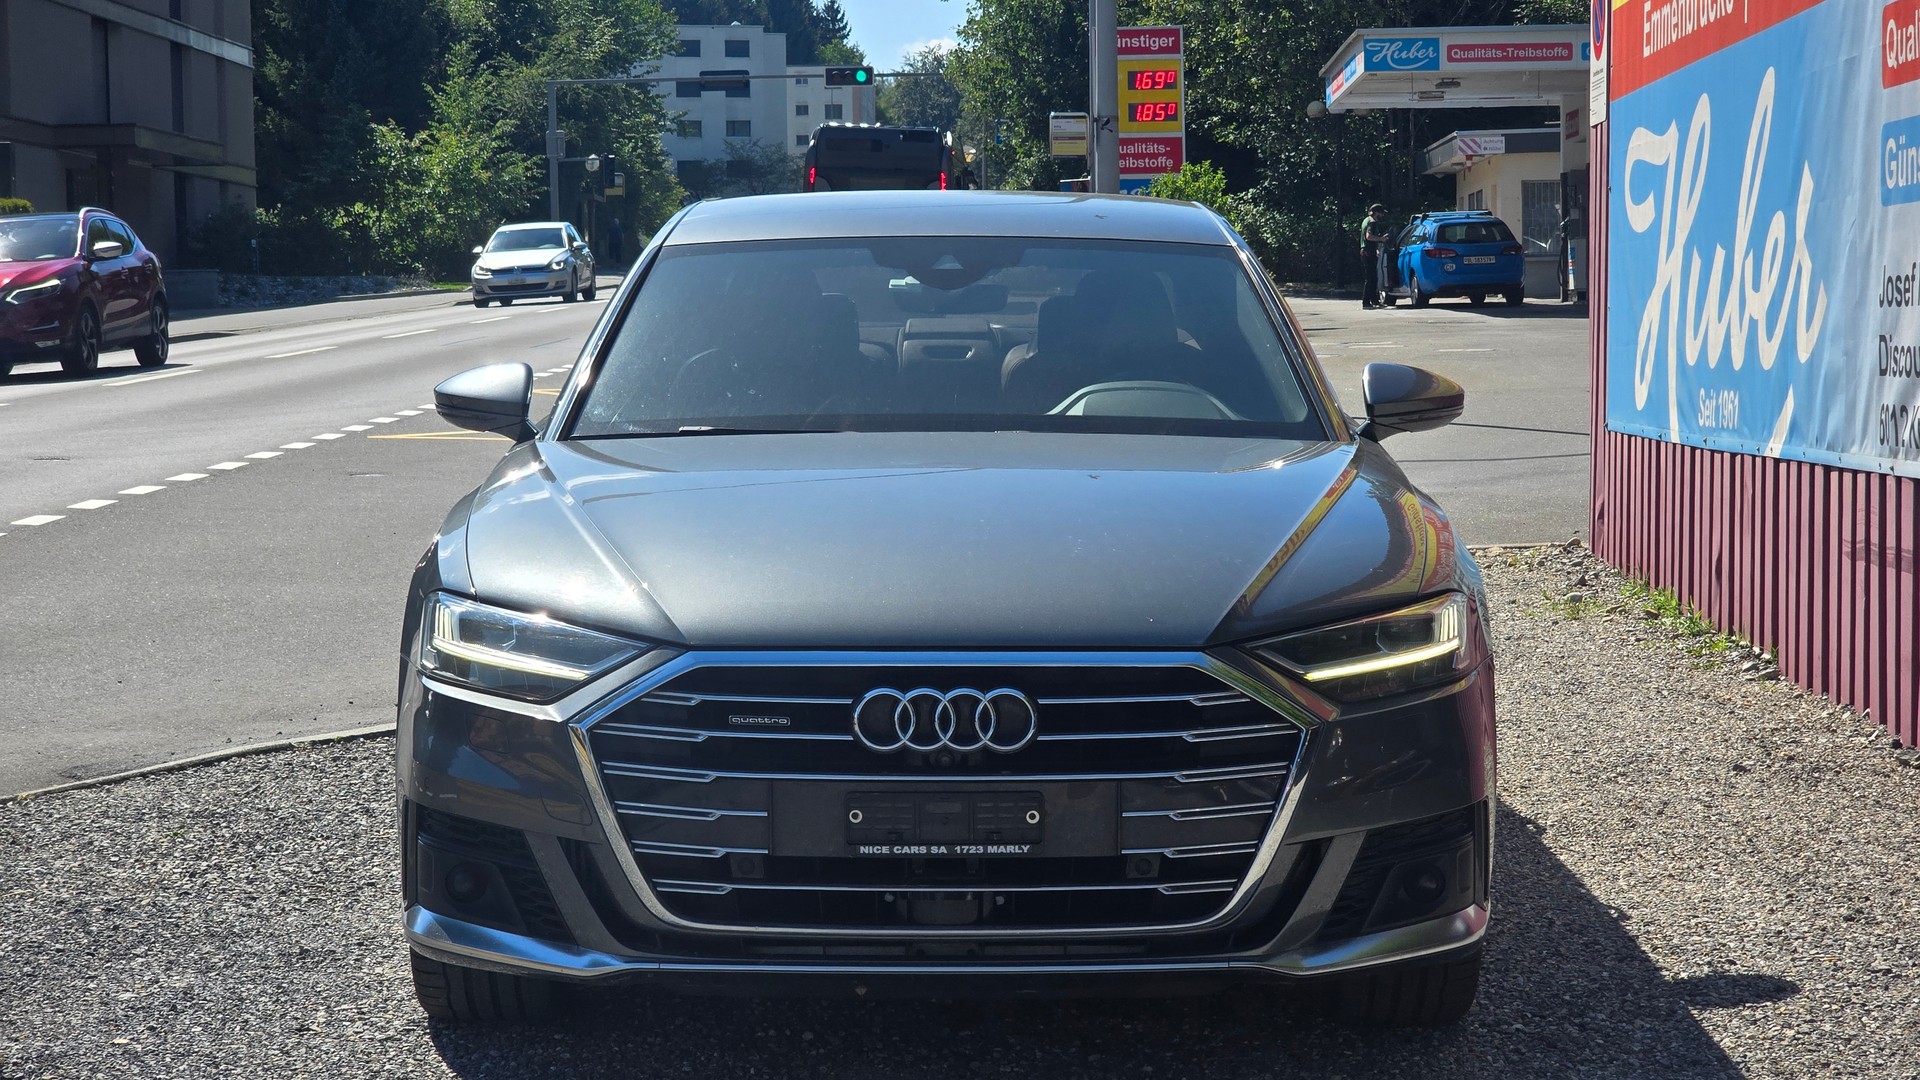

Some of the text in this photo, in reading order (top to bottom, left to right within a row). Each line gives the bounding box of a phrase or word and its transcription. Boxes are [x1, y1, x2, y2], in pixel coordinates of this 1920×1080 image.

[1366, 41, 1438, 69] Huber
[1451, 47, 1569, 60] Qualitäts-Treibstoffe
[1625, 67, 1827, 441] Huber
[1879, 262, 1917, 308] Josef
[1698, 387, 1739, 430] Seit 1961
[1880, 403, 1908, 447] 6012
[731, 716, 788, 725] quattro
[859, 845, 1030, 854] NICE CARS SA 1723 MARLY
